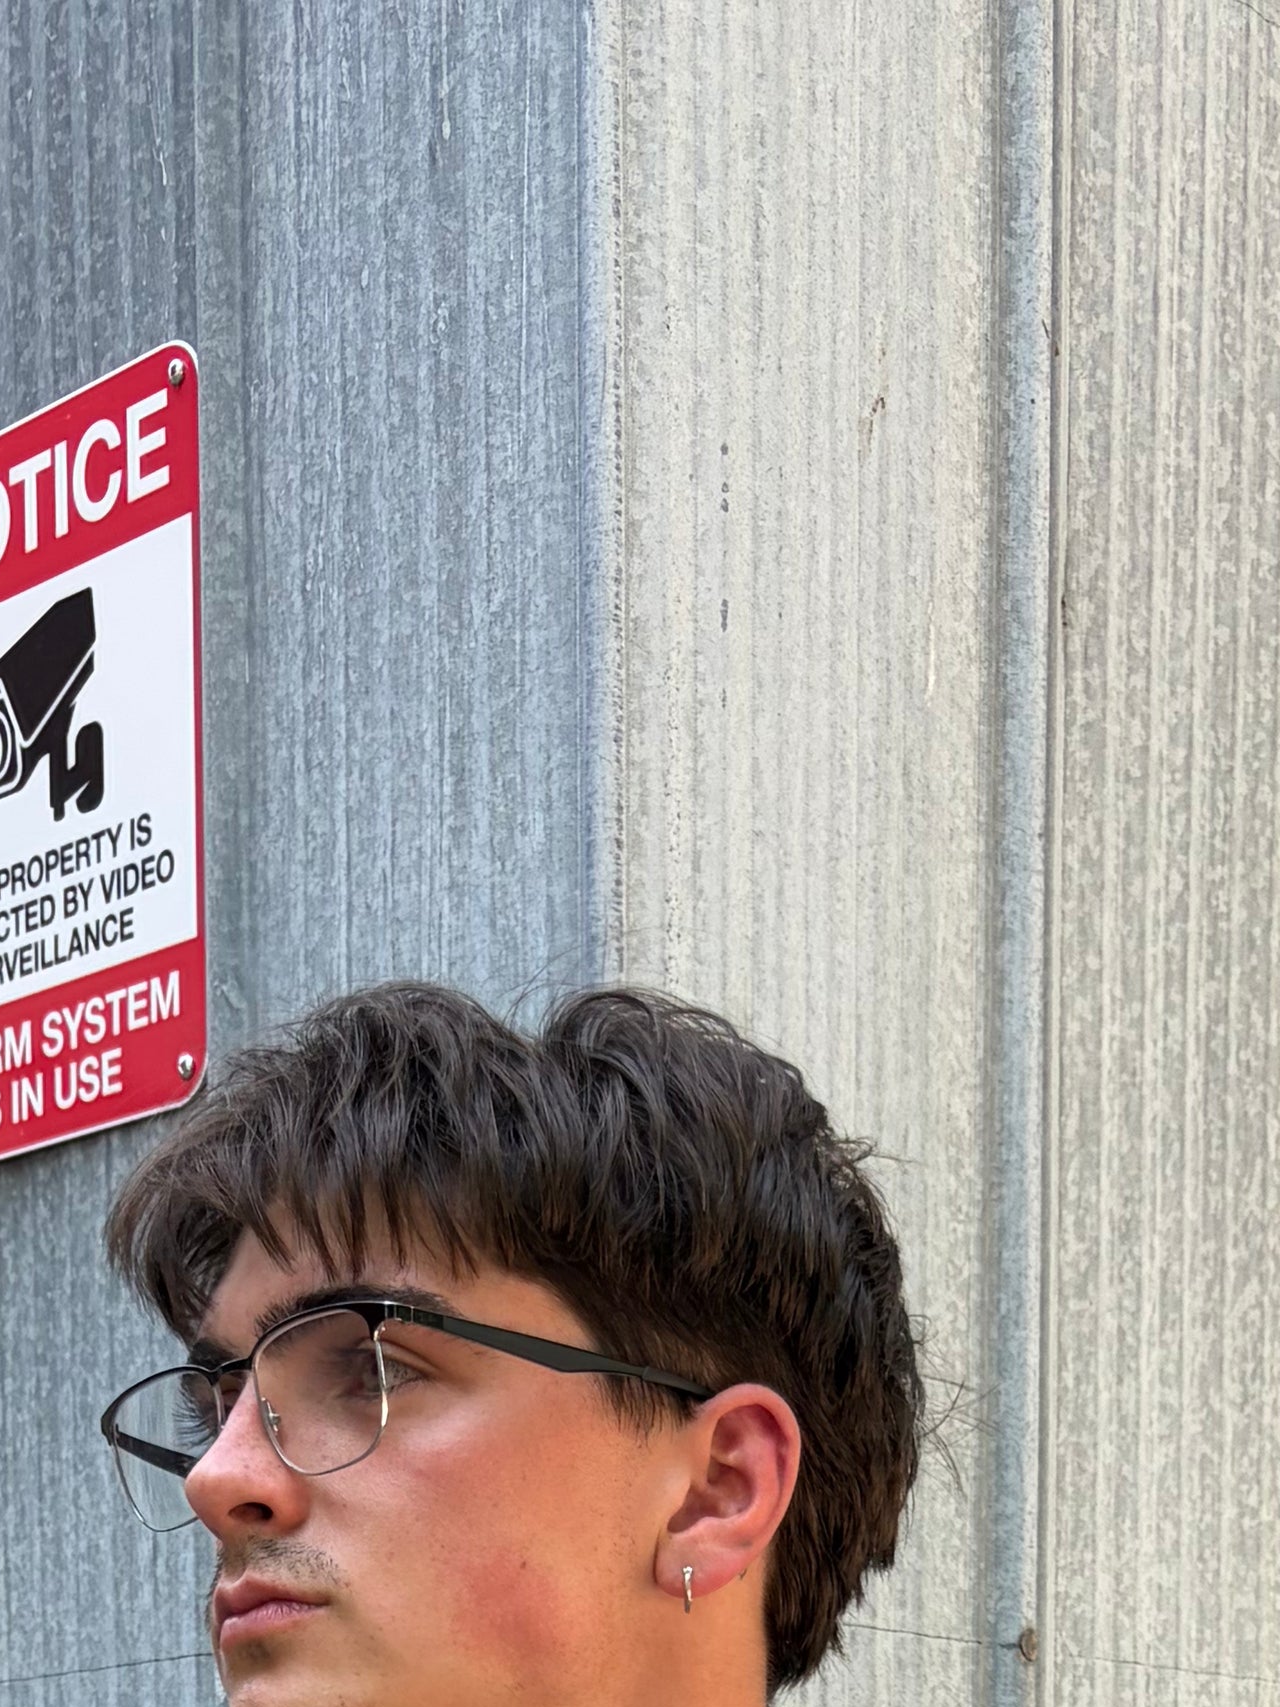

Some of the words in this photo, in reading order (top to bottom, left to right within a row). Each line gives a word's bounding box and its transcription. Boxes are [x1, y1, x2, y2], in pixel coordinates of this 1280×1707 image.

[130, 812, 152, 850] IS
[63, 877, 93, 919] BY
[100, 848, 174, 901] VIDEO
[41, 969, 181, 1058] SYSTEM
[11, 1071, 44, 1125] IN
[55, 1046, 123, 1110] USE
